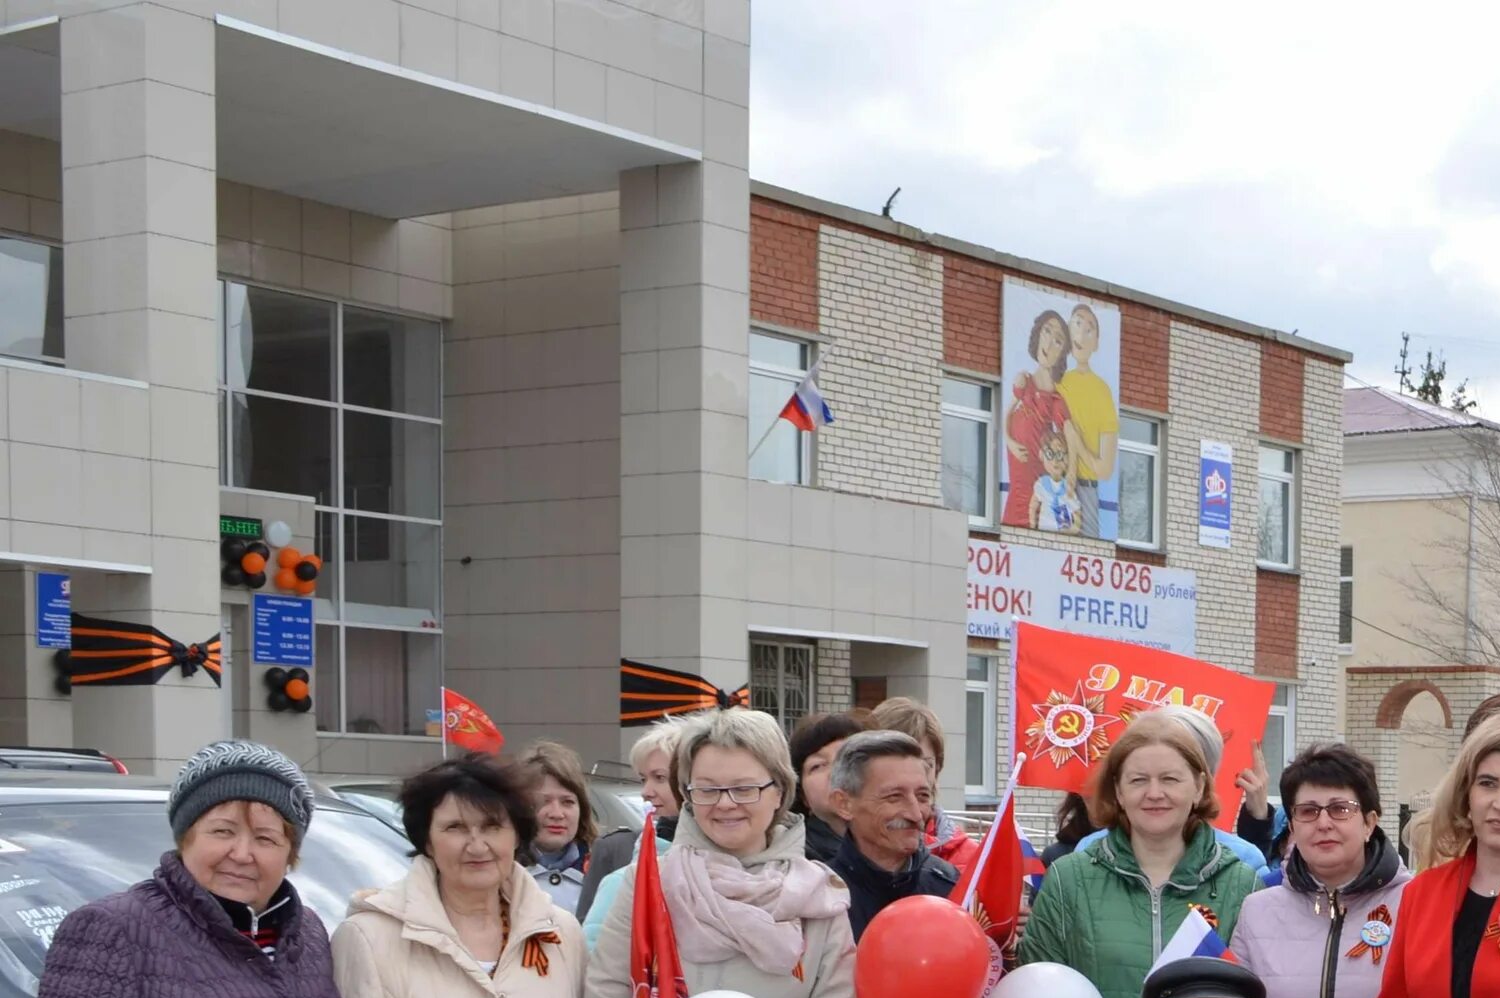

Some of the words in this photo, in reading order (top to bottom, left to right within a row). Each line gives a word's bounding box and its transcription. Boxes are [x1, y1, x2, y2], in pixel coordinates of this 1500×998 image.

[1060, 554, 1104, 588] 453
[1110, 562, 1152, 594] 026
[1059, 594, 1149, 630] PFRF.RU
[1085, 663, 1120, 691] 9
[1122, 675, 1224, 718] МАЯ
